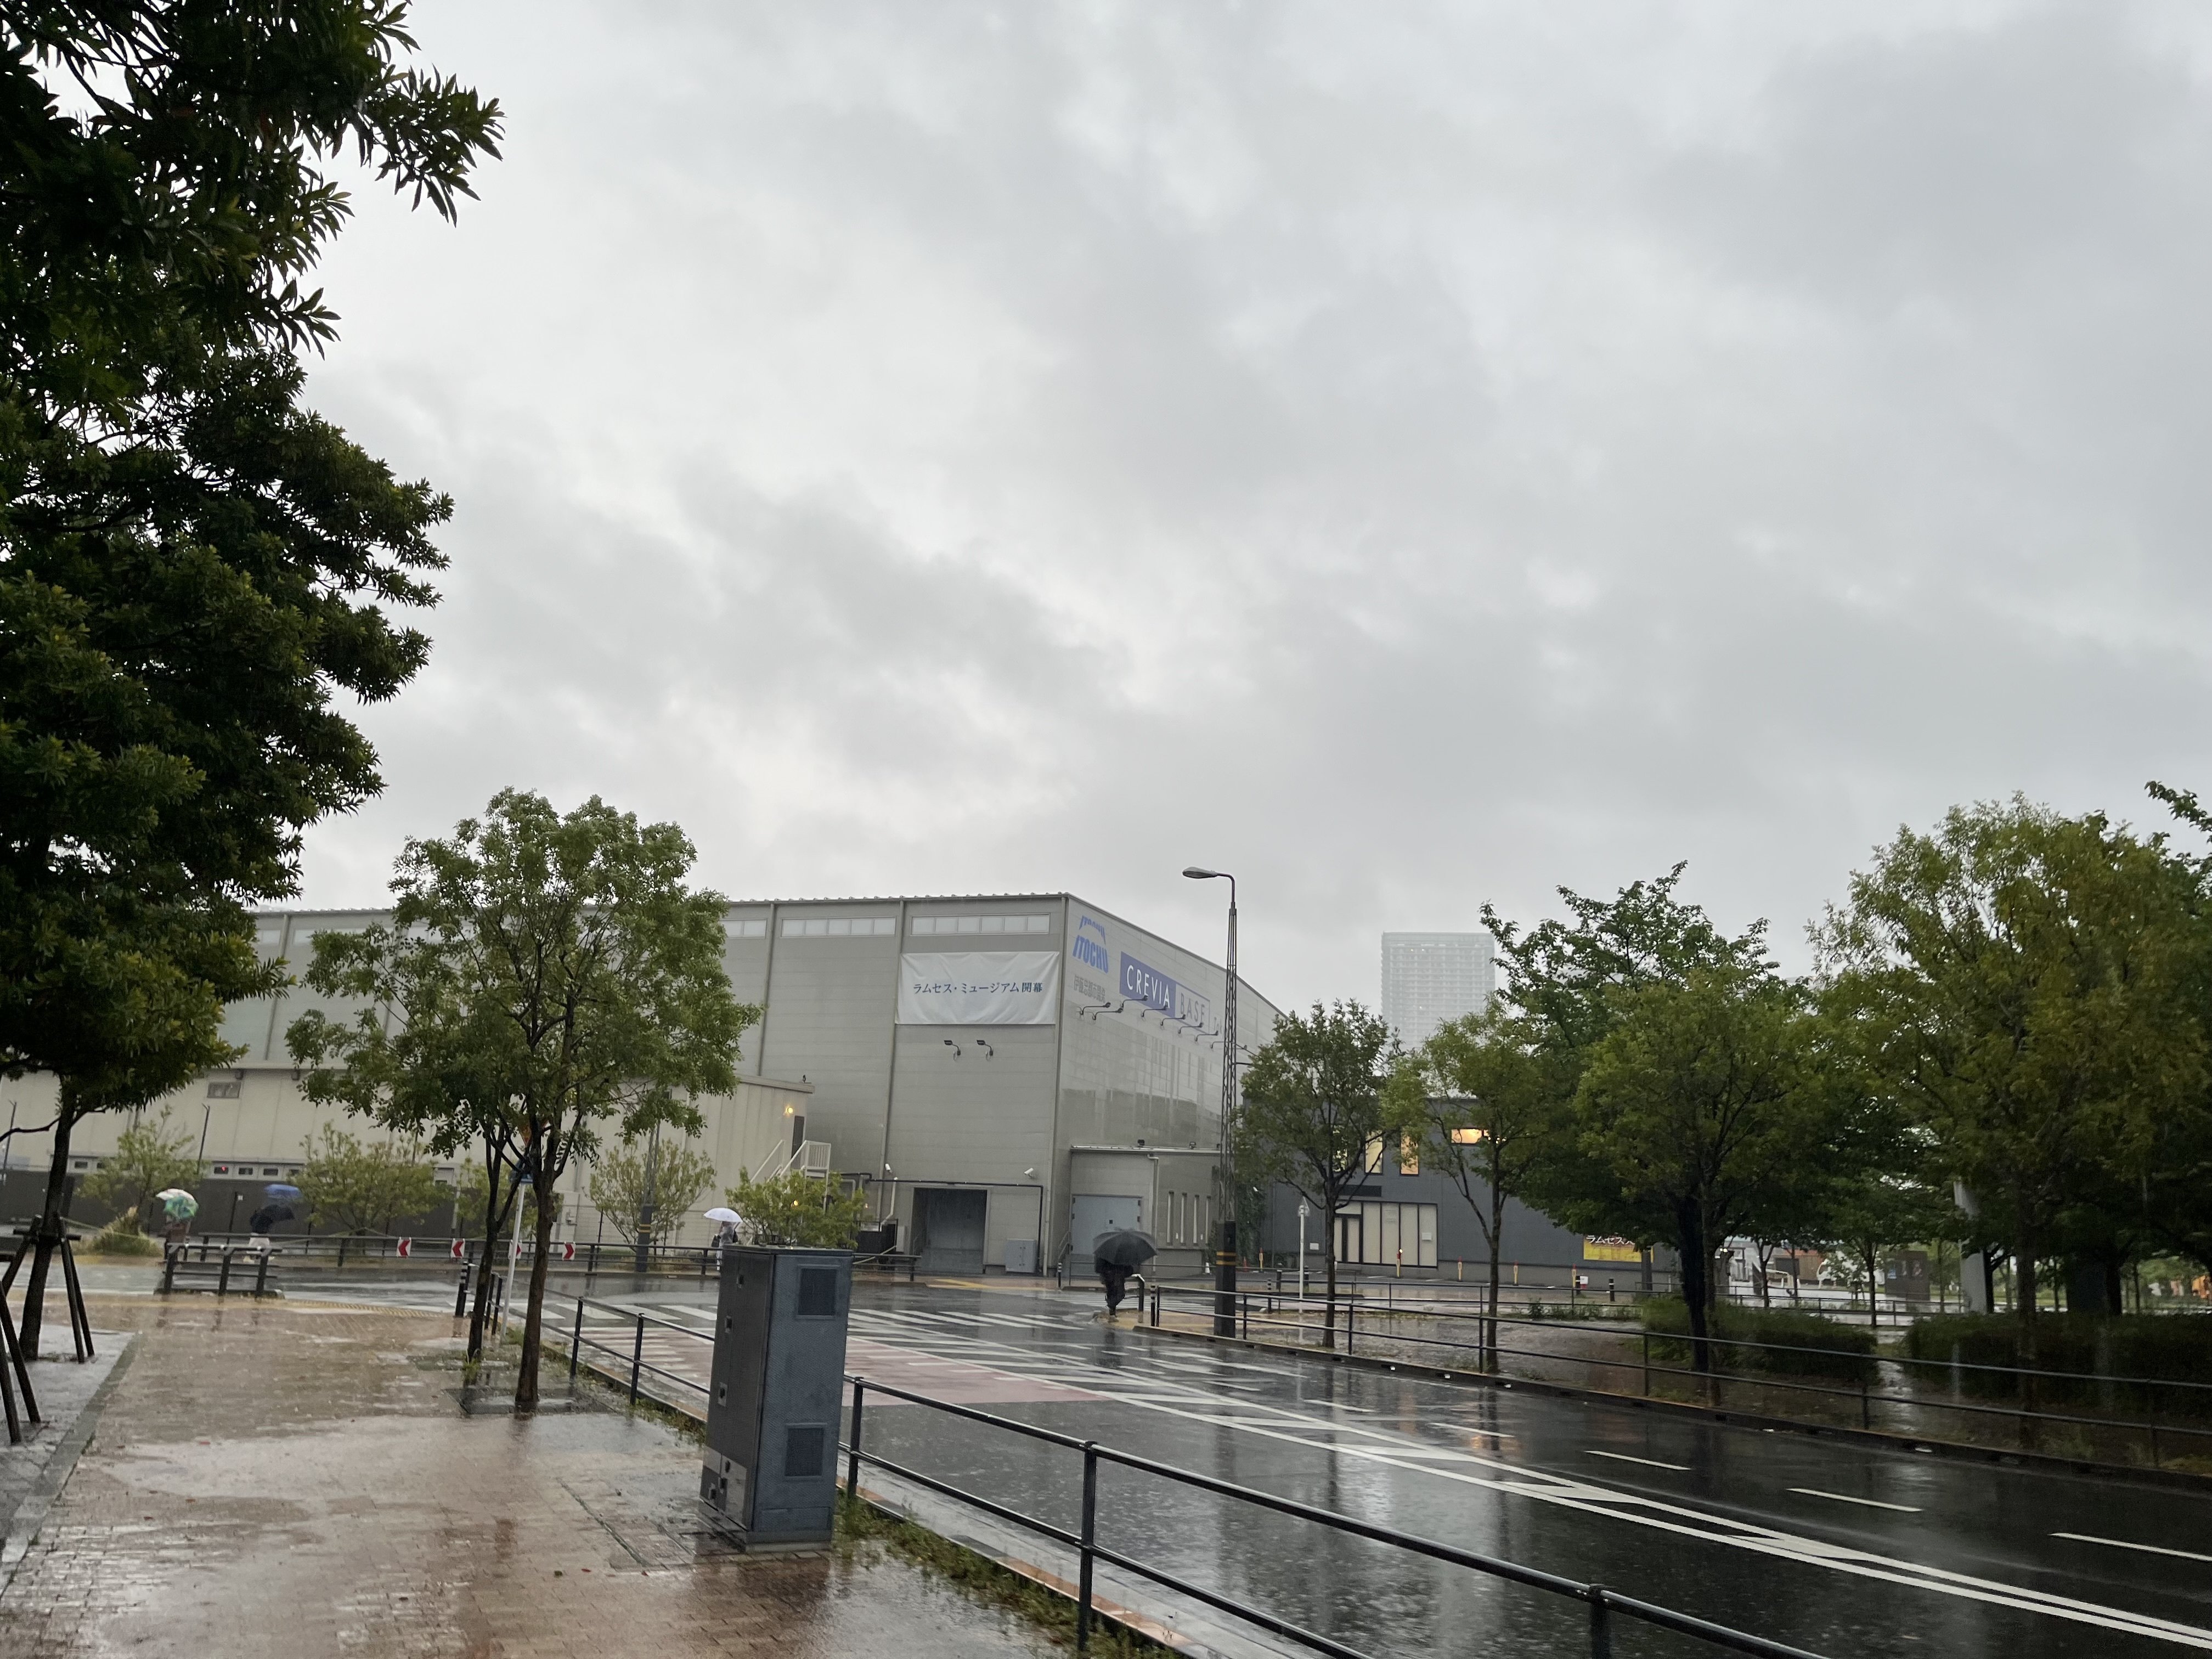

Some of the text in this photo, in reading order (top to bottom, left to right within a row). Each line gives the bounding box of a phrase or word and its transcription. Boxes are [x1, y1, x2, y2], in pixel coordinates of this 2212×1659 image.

[1073, 934, 1109, 974] ITOCHU
[913, 982, 1043, 994] ラムセス・ミュージアム開幕
[1126, 964, 1170, 1009] CREVIA
